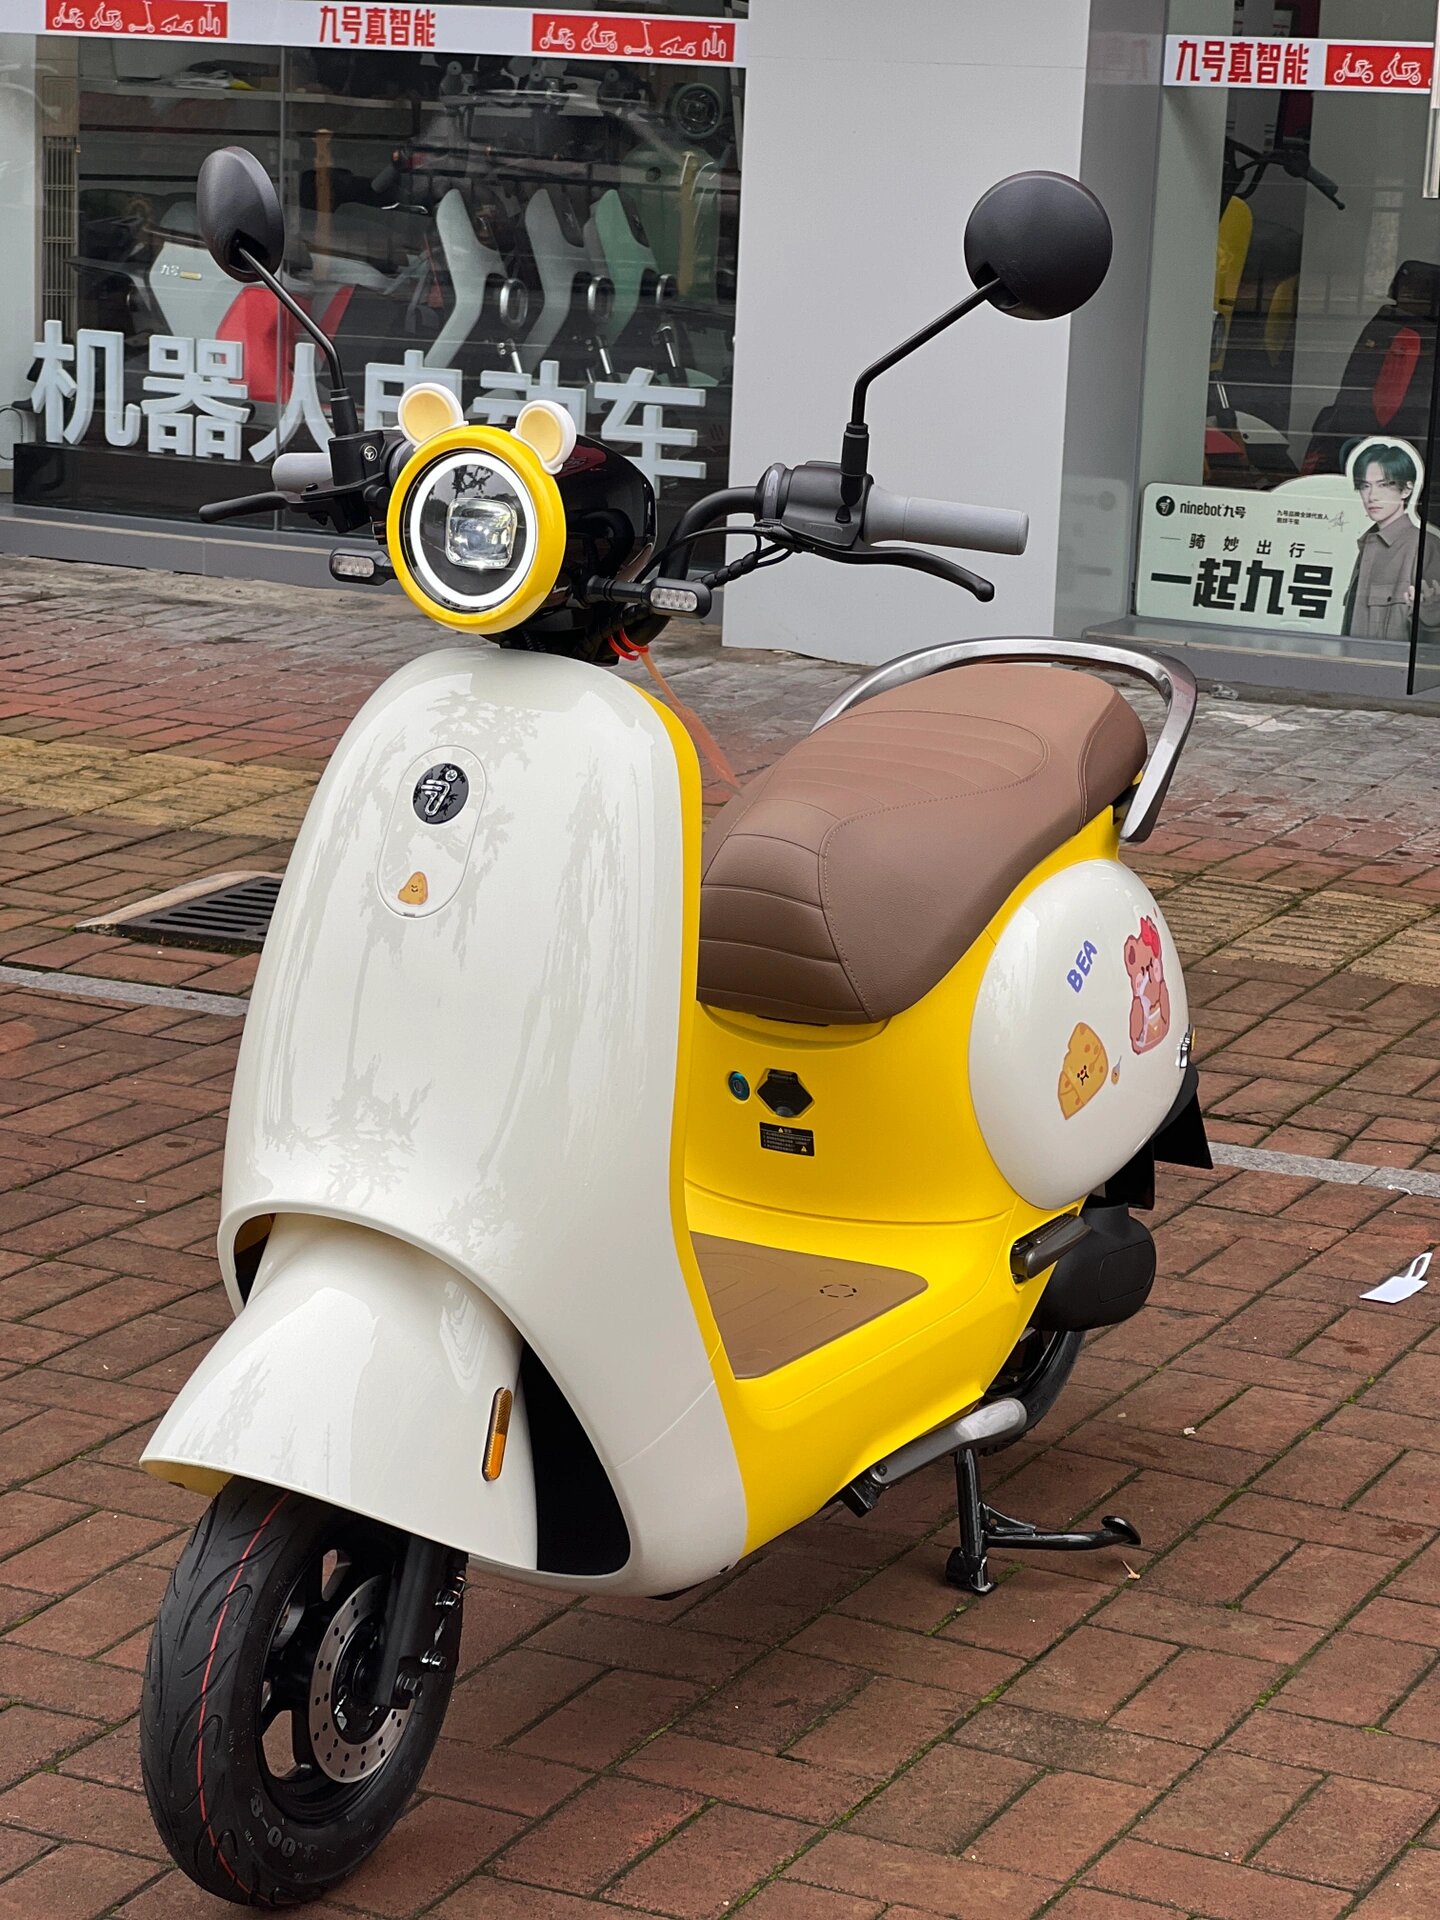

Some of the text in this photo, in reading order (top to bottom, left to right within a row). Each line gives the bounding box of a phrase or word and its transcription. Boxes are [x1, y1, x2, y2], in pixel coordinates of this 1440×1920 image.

[319, 5, 436, 47] 九号真智能
[1175, 40, 1309, 85] 九号真智能
[1151, 557, 1334, 619] 一起九号
[1066, 939, 1098, 993] BEA
